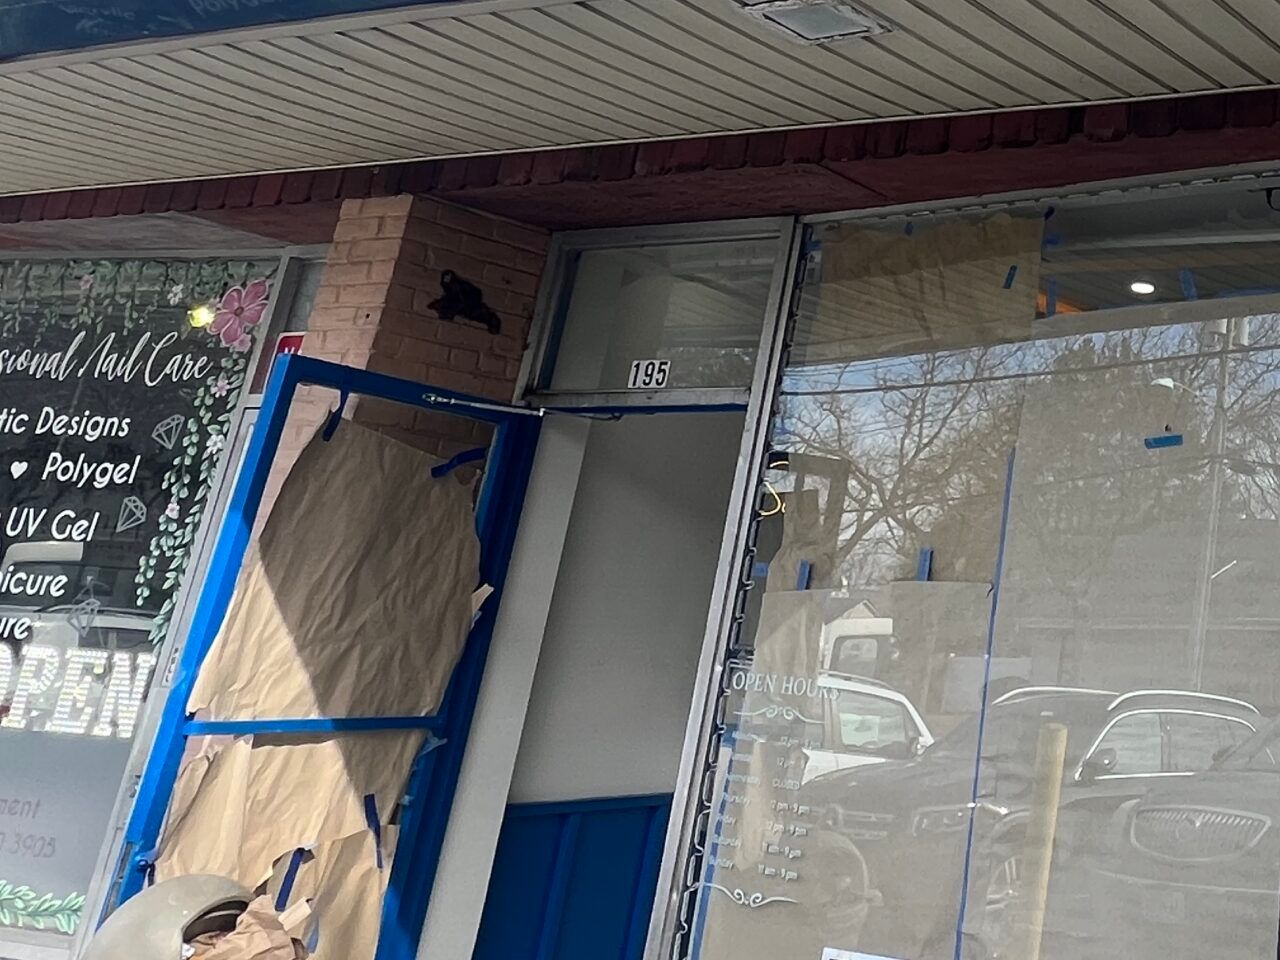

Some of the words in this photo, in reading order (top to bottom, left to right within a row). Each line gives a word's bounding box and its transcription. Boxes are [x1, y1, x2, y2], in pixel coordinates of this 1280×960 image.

[77, 331, 151, 383] Nail
[144, 331, 214, 387] Care
[632, 360, 669, 388] 195
[35, 406, 131, 442] Designs
[41, 451, 141, 489] Polygel
[6, 506, 48, 538] UV
[51, 509, 100, 542] Gel
[732, 670, 777, 694] OPEN
[781, 675, 840, 701] HOURS
